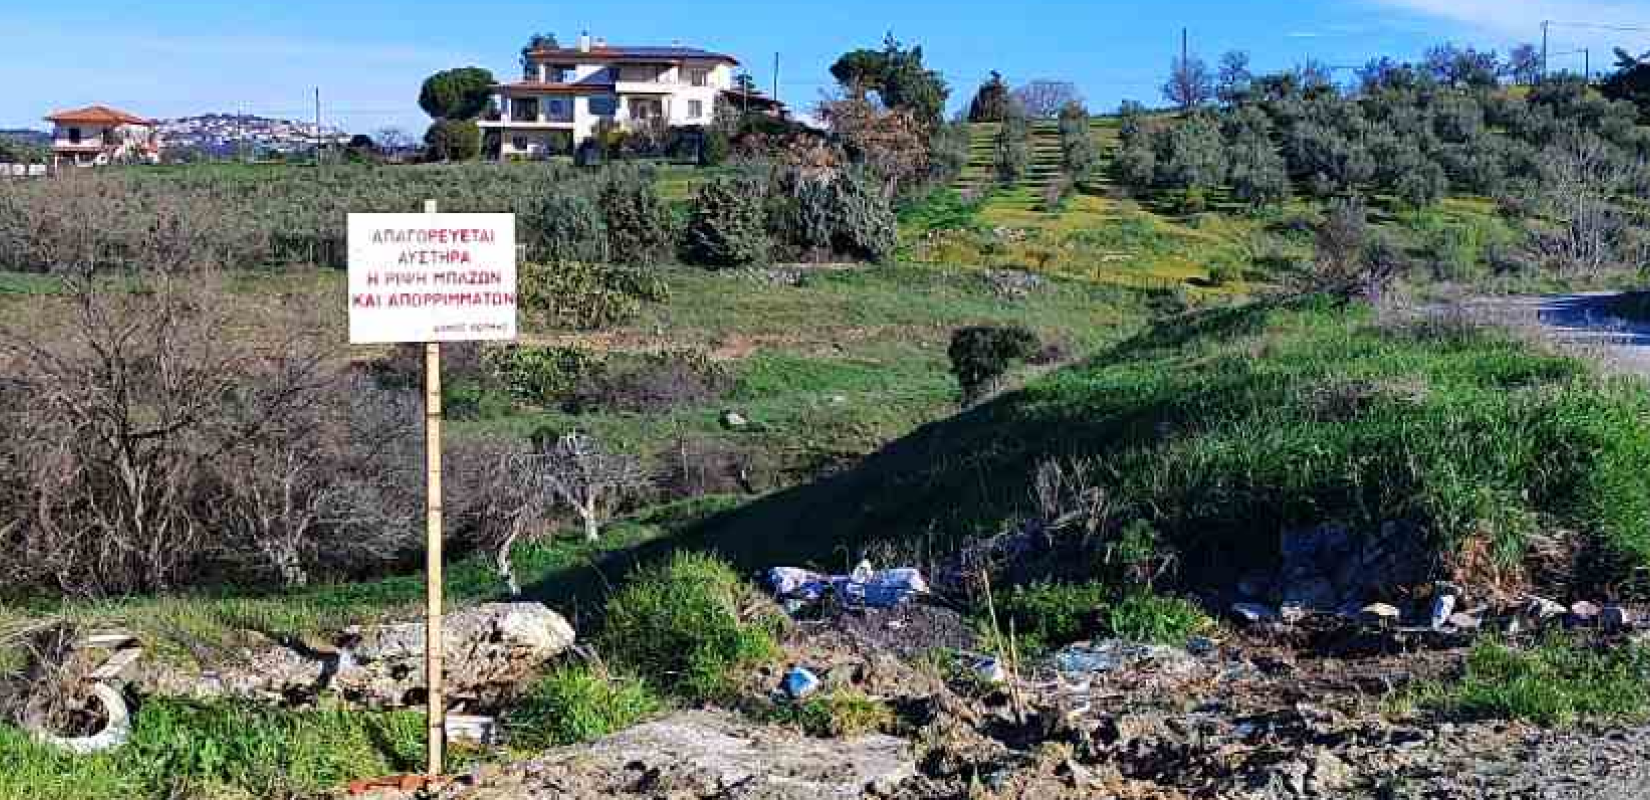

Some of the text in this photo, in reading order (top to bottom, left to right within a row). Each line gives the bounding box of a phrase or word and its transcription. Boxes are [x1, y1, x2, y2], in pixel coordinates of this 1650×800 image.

[372, 229, 495, 244] ΑΠΑΓΟΡΕΥΕΤΑΙ
[398, 250, 471, 264] ΑΥΣΤΗΡΑ
[367, 272, 501, 285] Η ΡΙΨΗ ΜΠΑΖΩΝ
[352, 292, 515, 308] ΚΑΙ ΑΠΟΡΡΙΜΜΑΤΩΝ
